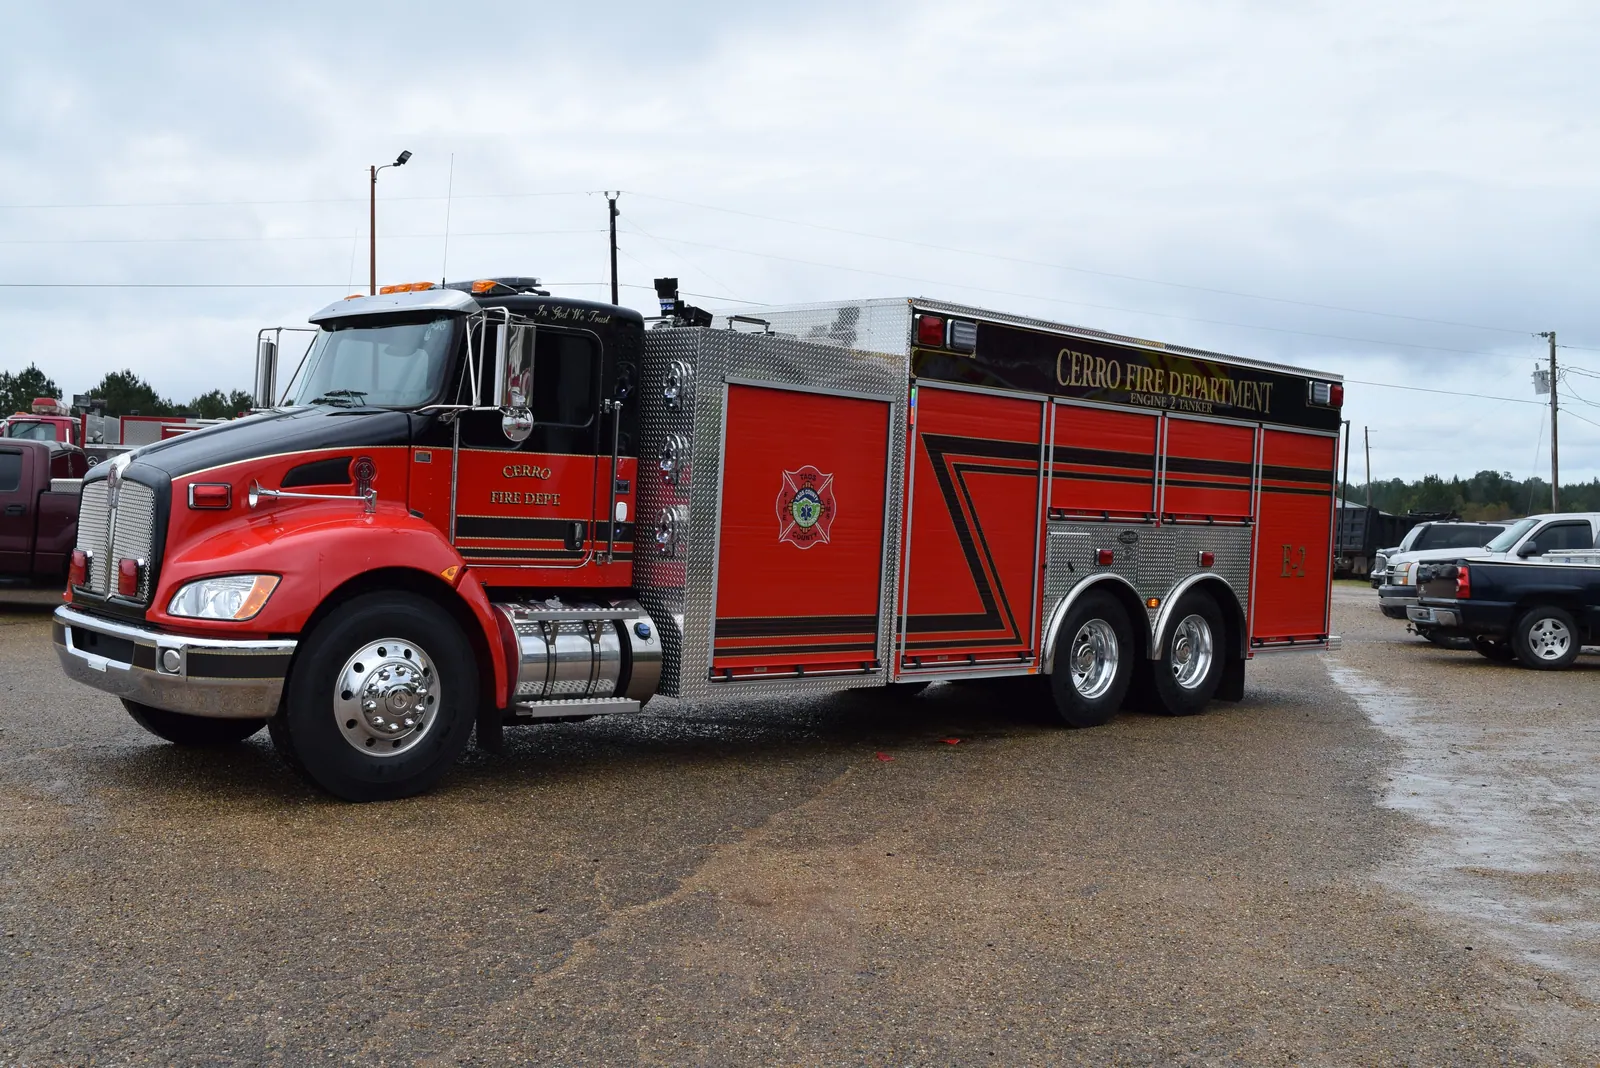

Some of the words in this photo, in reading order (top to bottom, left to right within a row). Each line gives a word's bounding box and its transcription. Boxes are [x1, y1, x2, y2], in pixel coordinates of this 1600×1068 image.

[535, 304, 548, 317] In
[551, 306, 571, 320] God
[572, 308, 585, 321] We
[588, 310, 611, 324] Trust
[1056, 348, 1121, 389] CERRO
[1125, 363, 1165, 394] FIRE
[1168, 371, 1274, 414] DEPARTMENT
[1130, 392, 1168, 408] ENGINE
[1169, 396, 1177, 410] 2
[1179, 398, 1213, 413] TANKER
[502, 464, 552, 480] CERRO
[490, 491, 522, 504] FIRE
[1280, 544, 1306, 578] E-2
